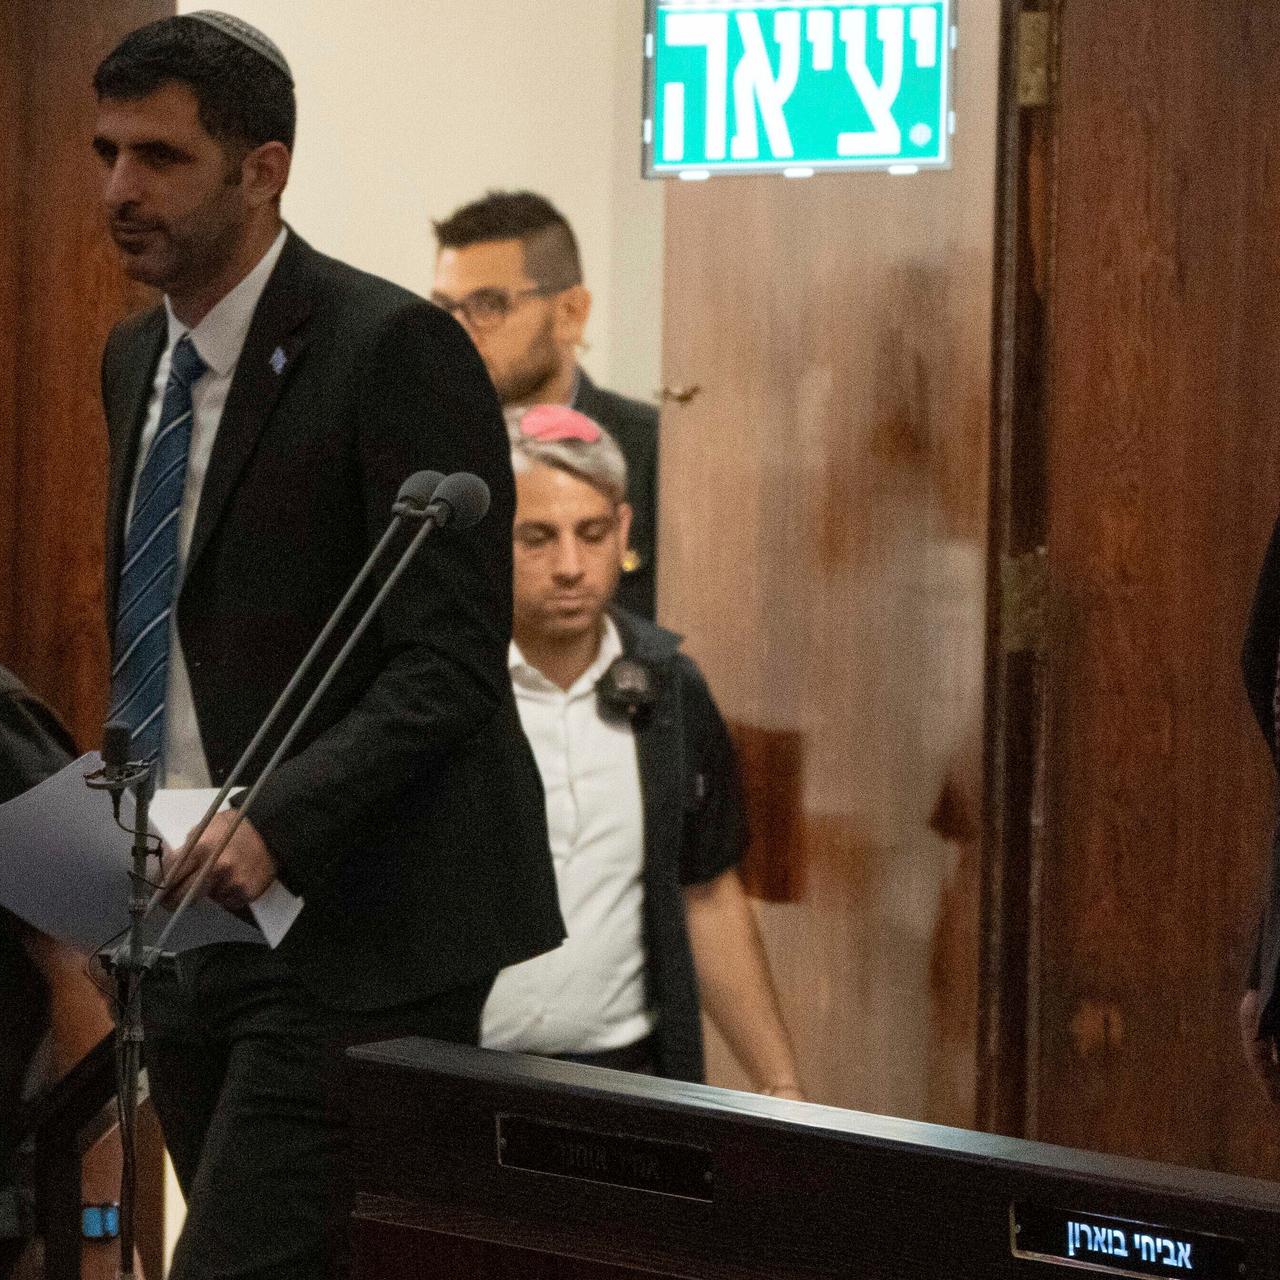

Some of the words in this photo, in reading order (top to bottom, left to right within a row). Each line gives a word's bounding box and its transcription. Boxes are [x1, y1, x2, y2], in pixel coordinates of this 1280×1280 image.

[662, 7, 937, 161] יציאה
[1066, 1220, 1129, 1257] בוארון
[1133, 1233, 1193, 1270] אביחי
